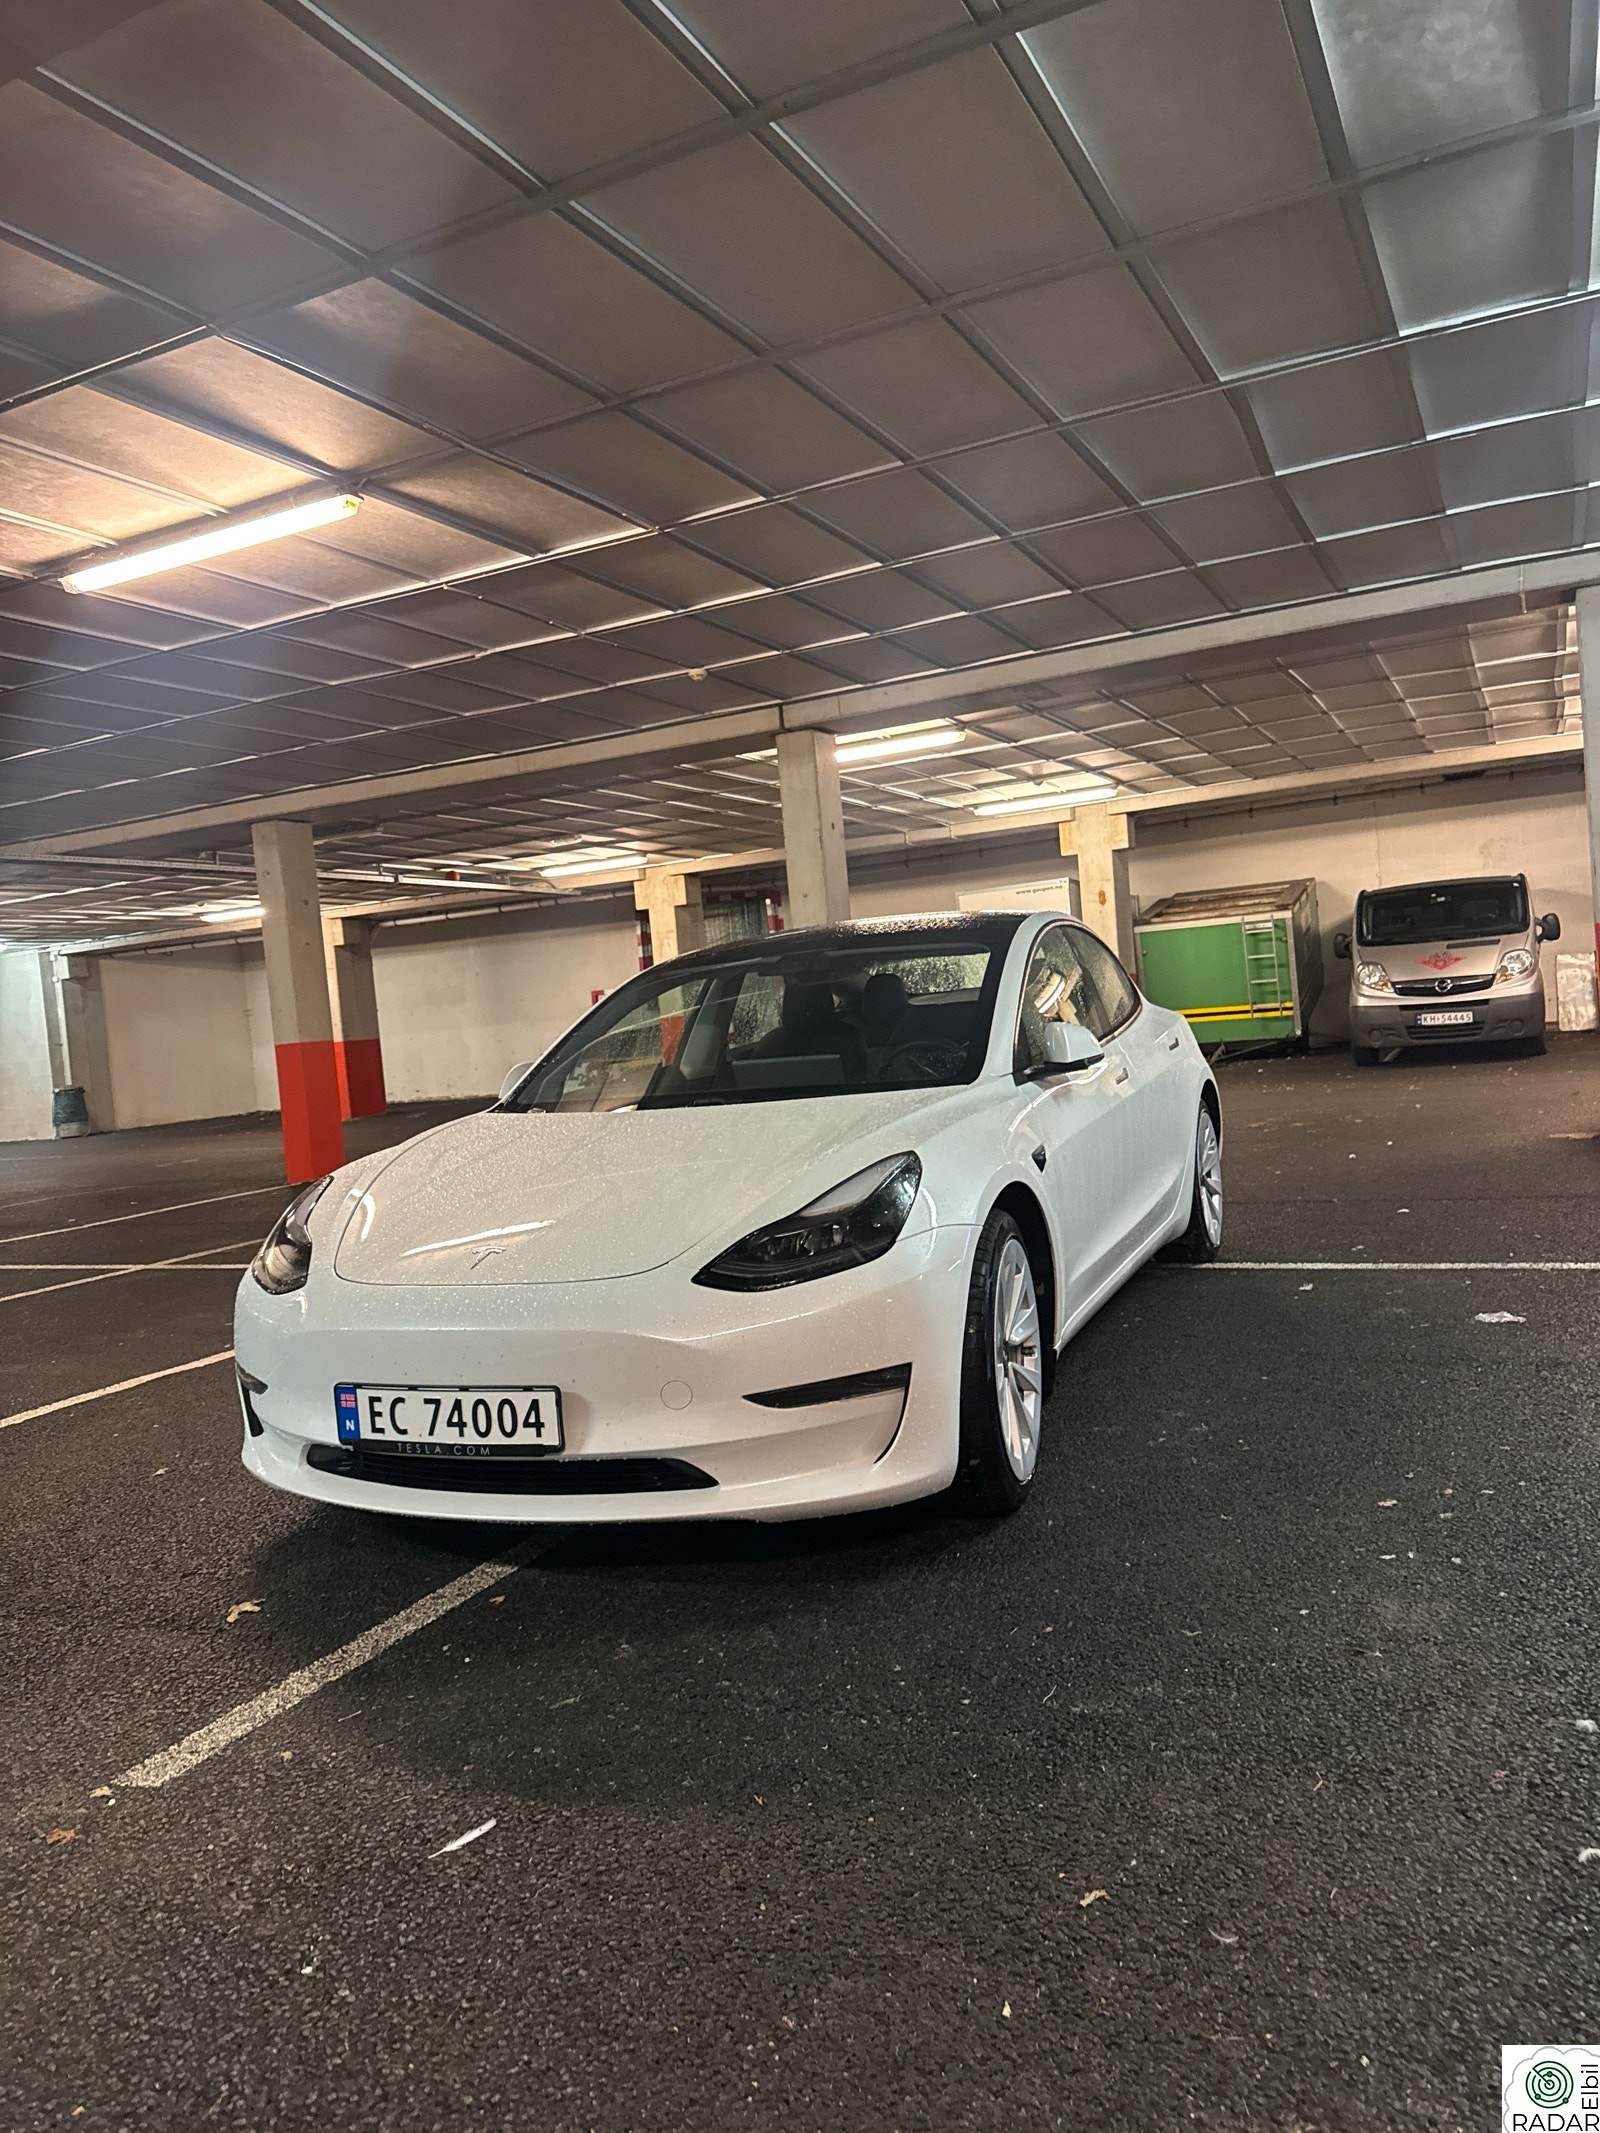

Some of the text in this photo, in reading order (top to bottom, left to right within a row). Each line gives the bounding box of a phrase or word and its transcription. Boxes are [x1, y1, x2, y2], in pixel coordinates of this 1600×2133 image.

[1423, 1013, 1471, 1024] KH 54445
[367, 1395, 545, 1439] EC 74004
[345, 1419, 355, 1431] N
